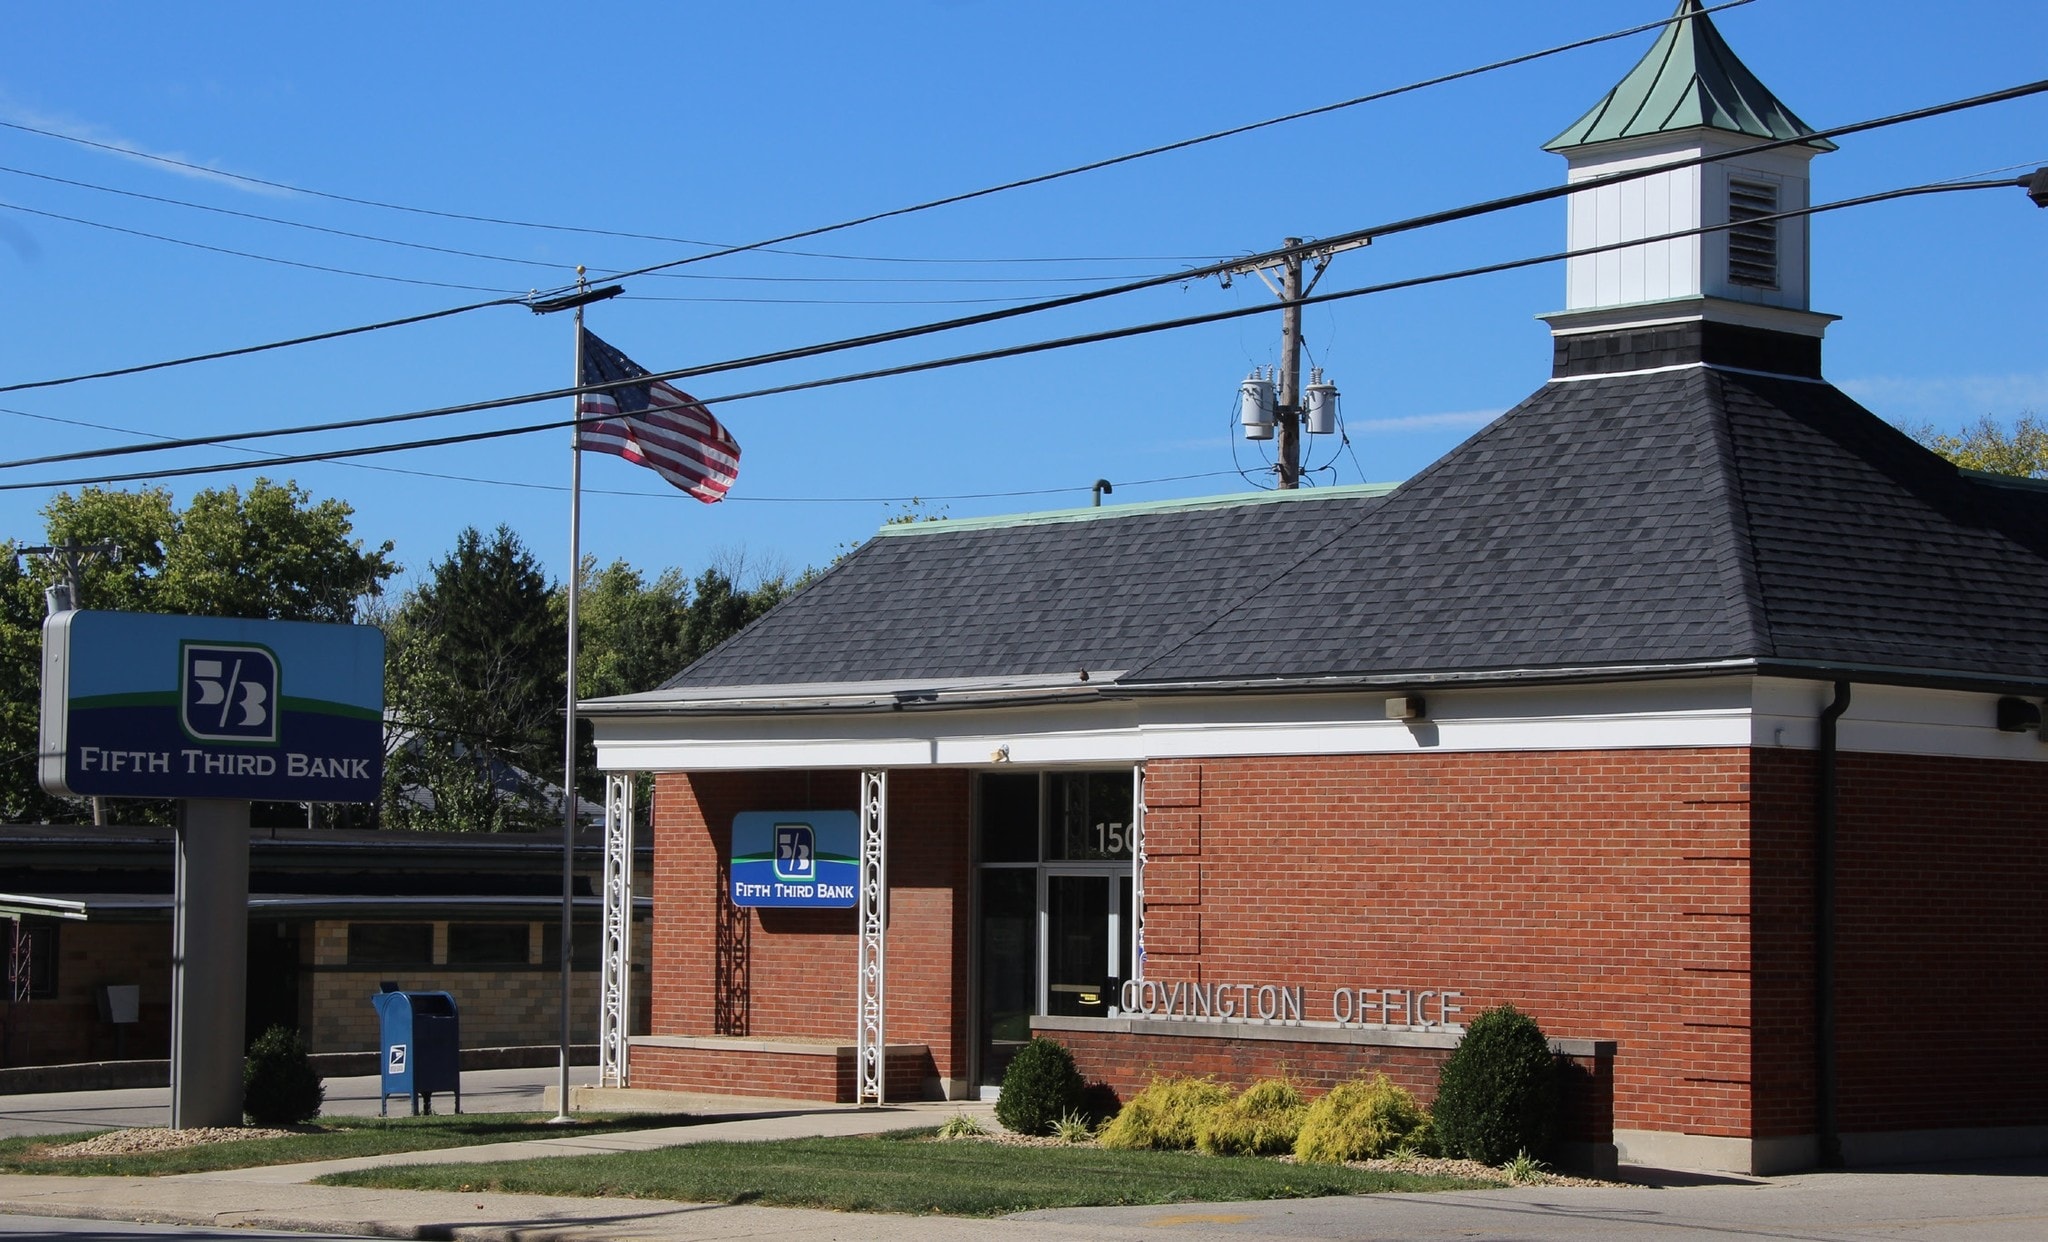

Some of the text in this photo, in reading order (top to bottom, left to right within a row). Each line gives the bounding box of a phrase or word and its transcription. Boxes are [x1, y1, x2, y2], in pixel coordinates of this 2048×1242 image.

[79, 746, 371, 780] FIFTH THIRD BANK
[735, 882, 854, 899] FIFTH THIRD BANK
[1120, 979, 1462, 1029] COVINGTON OFFICE
